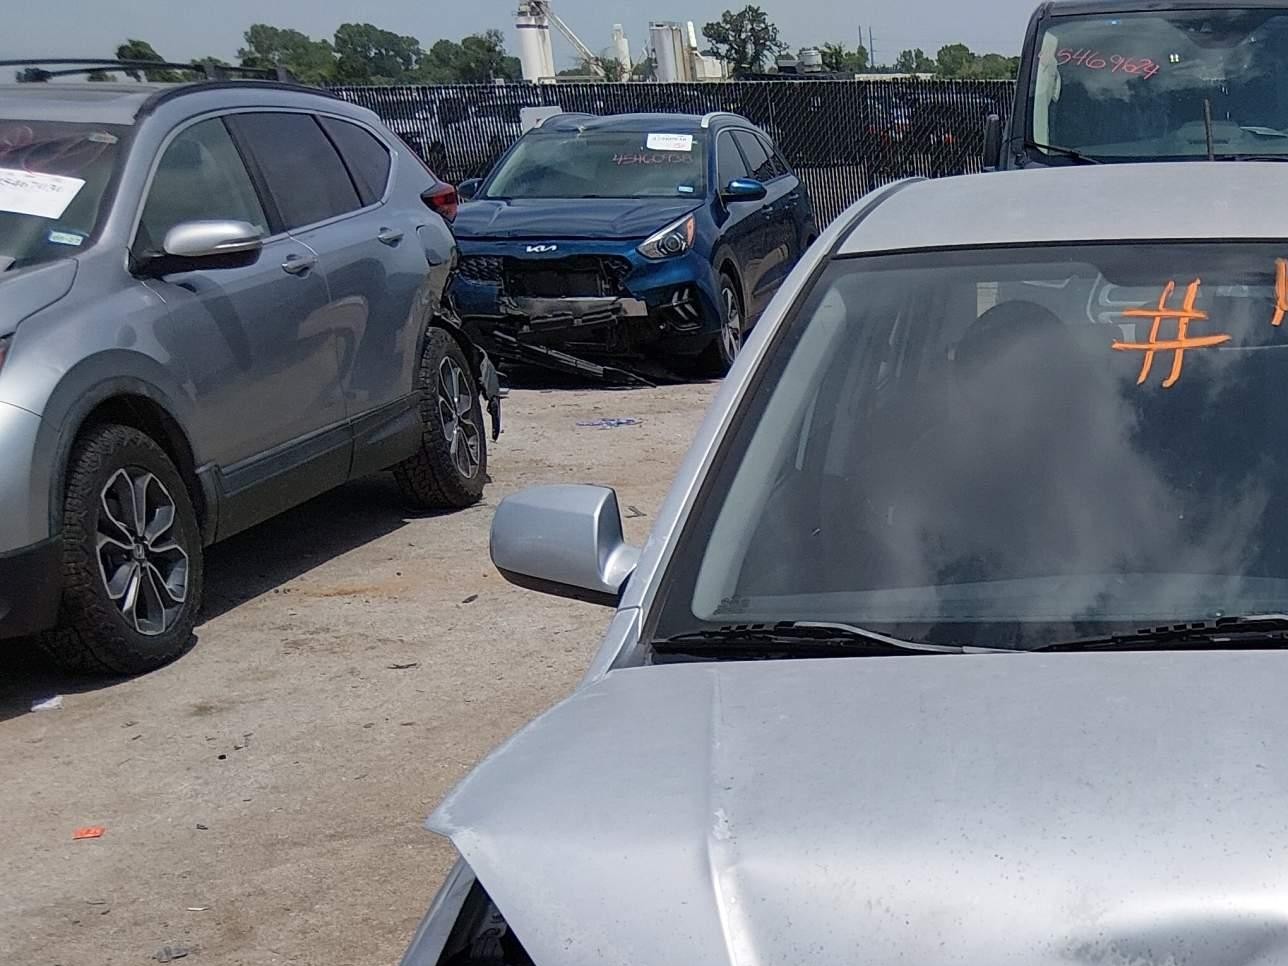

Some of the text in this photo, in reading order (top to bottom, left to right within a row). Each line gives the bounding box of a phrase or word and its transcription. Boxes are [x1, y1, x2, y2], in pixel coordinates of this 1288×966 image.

[1038, 47, 1160, 80] 5469624
[526, 244, 558, 253] KIA
[1111, 277, 1232, 388] #
